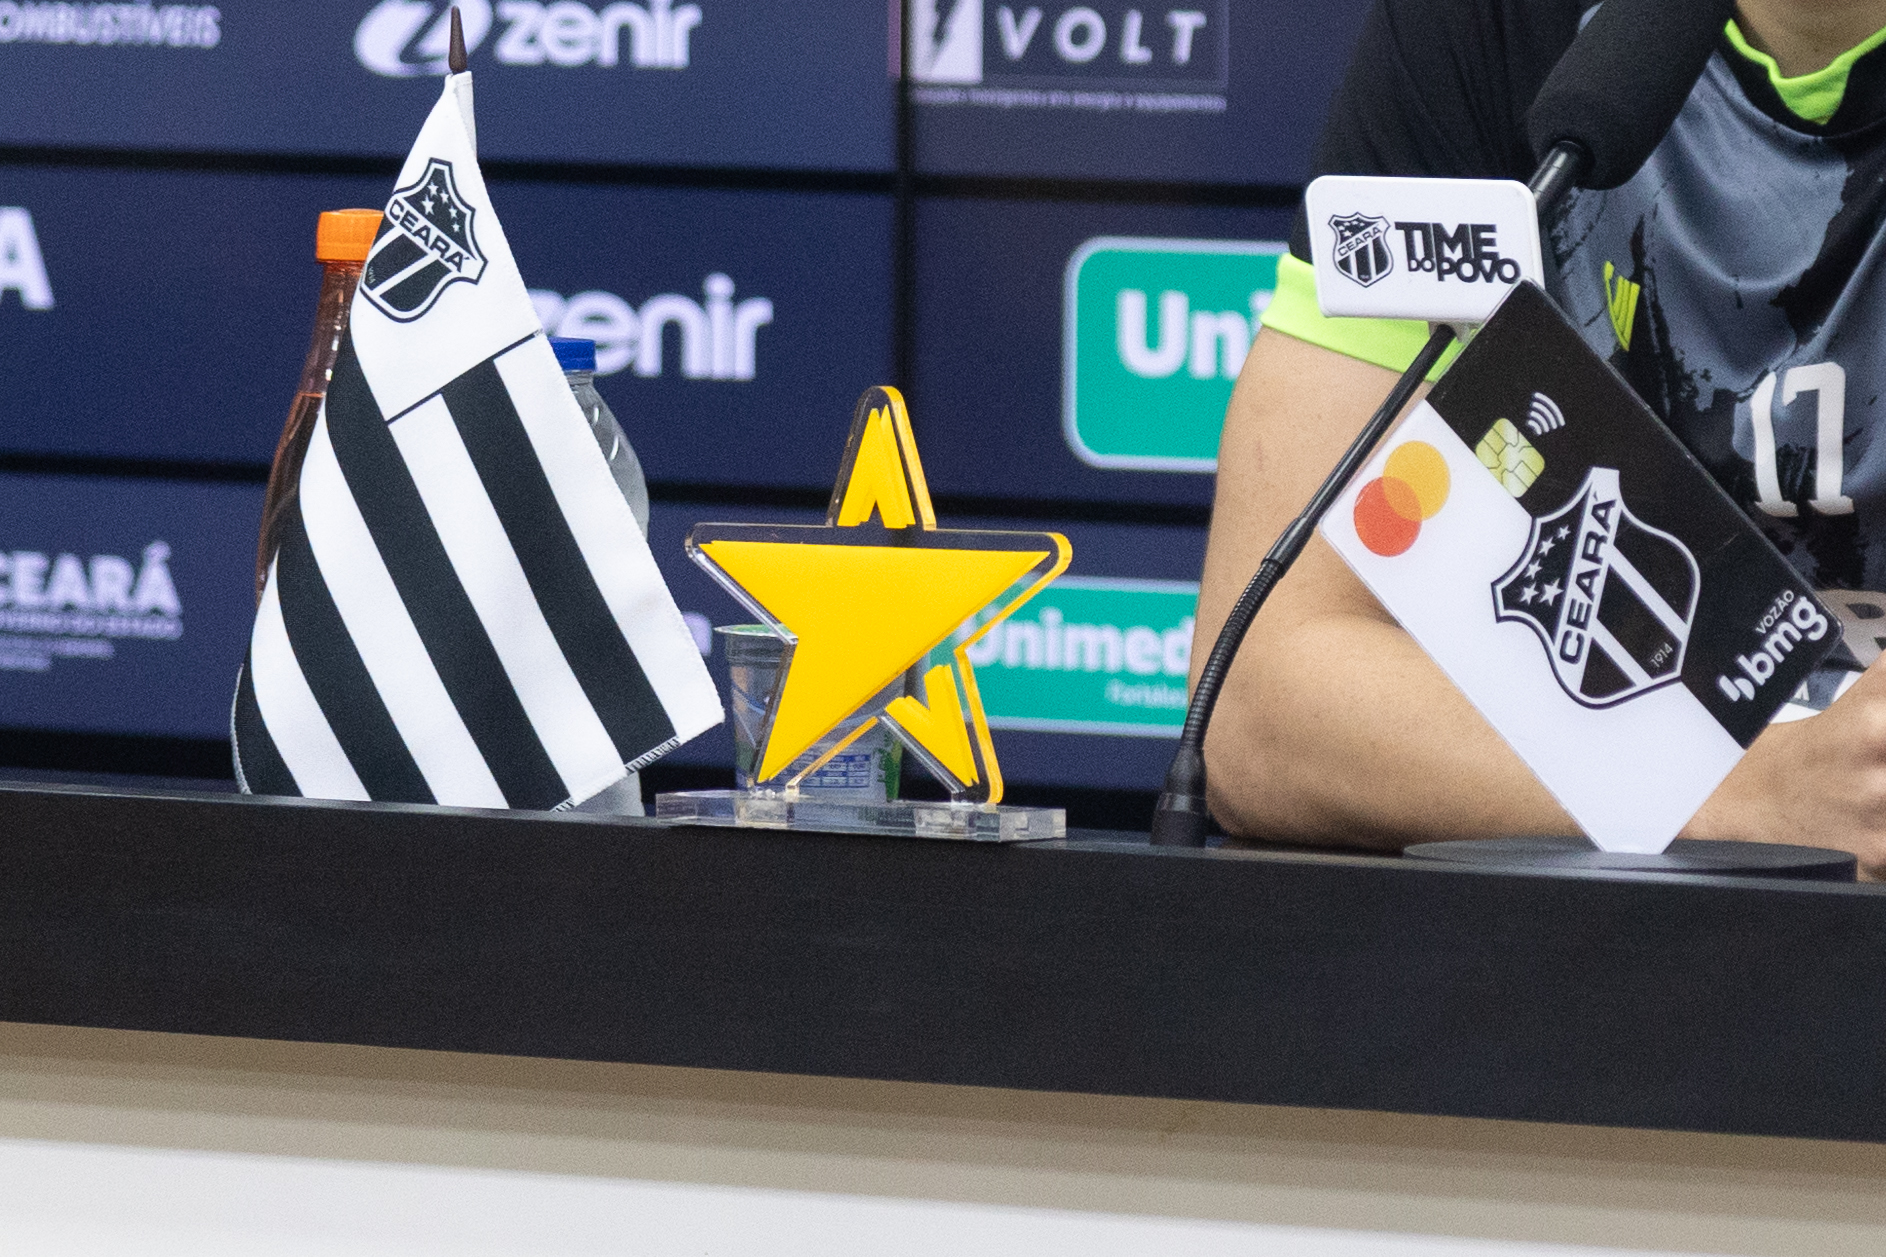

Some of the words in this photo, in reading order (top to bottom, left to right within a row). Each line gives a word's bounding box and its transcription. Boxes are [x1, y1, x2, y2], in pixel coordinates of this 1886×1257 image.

[998, 7, 1206, 64] VOLT
[389, 198, 470, 273] CEARÁ
[1337, 223, 1382, 258] CEARÁ
[1394, 220, 1499, 261] TIME
[1407, 256, 1437, 273] DO
[1436, 255, 1522, 285] POVO
[1751, 361, 1855, 517] 17
[1559, 491, 1619, 665] CEARÁ
[1755, 589, 1795, 636] VOZÃO
[1650, 643, 1674, 668] 1914
[1737, 595, 1830, 686] bmg
